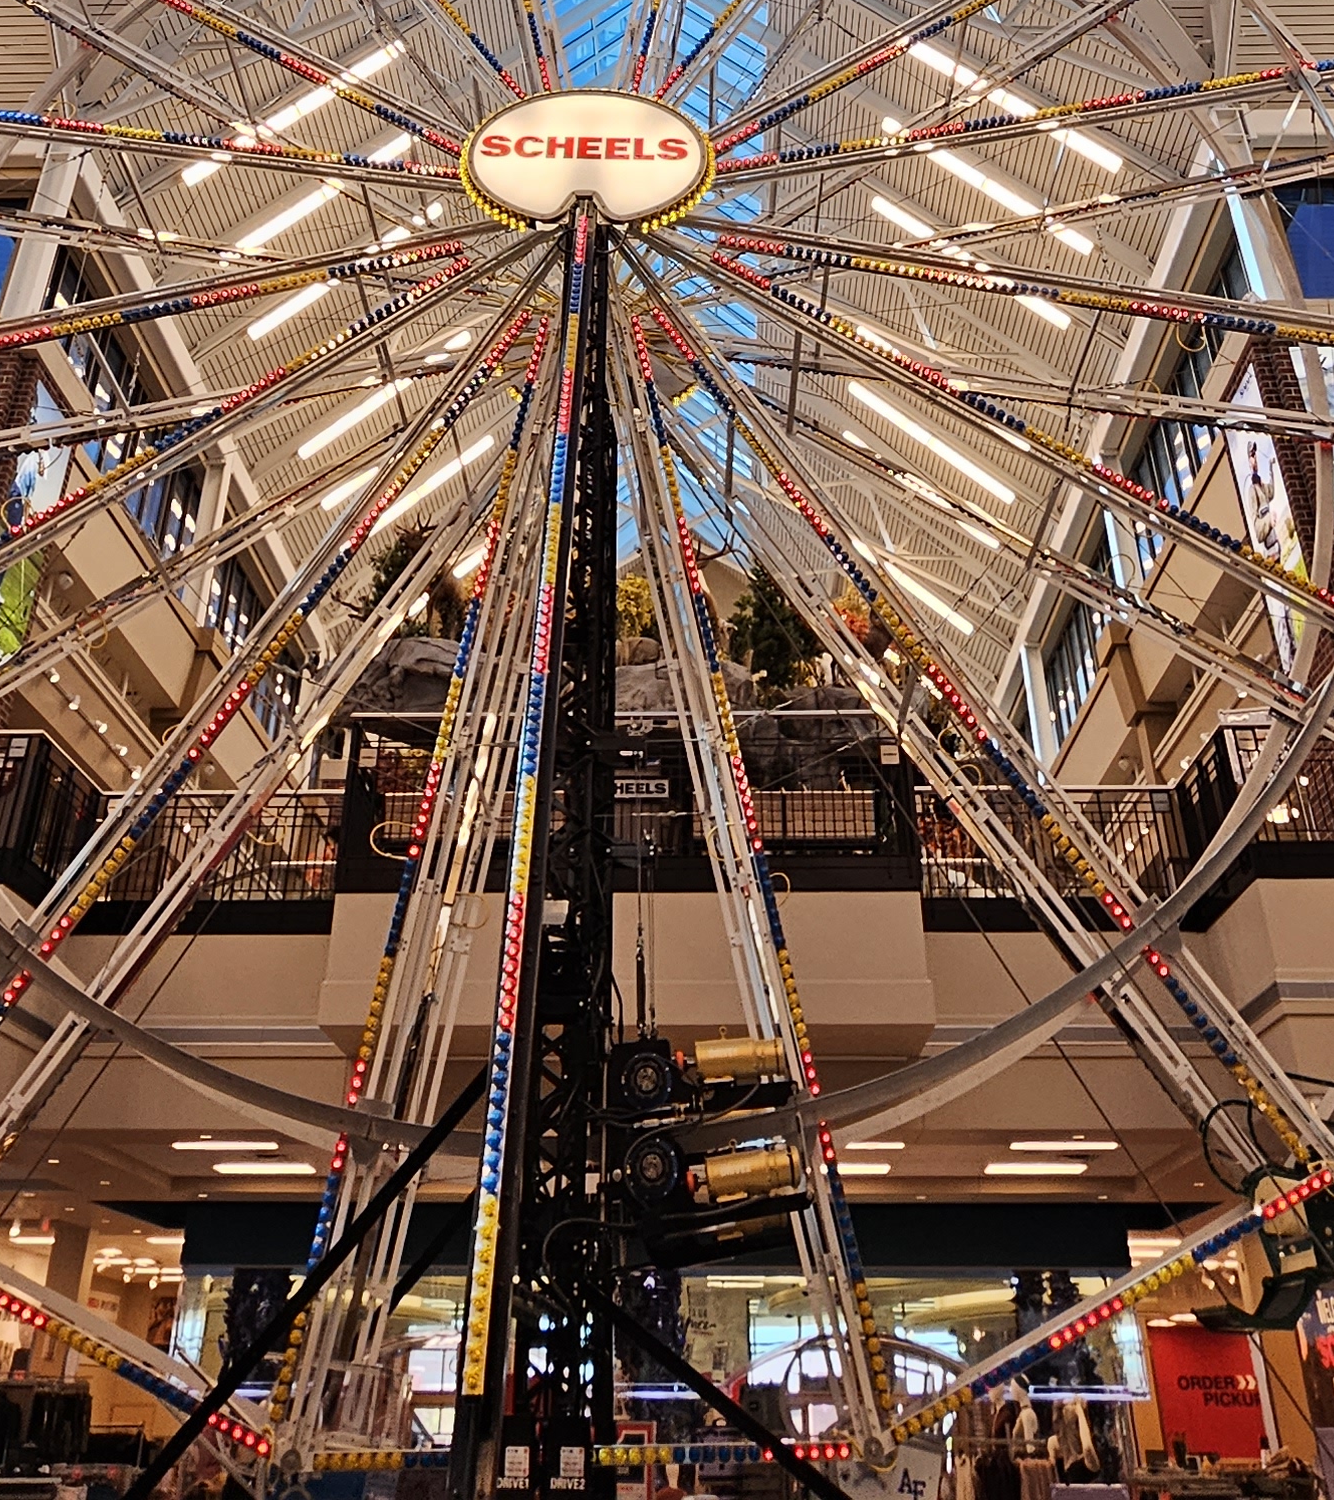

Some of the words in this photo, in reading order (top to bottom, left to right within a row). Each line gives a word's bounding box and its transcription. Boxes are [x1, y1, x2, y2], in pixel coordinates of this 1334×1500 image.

[480, 135, 688, 161] SCHEELS
[1177, 1374, 1236, 1391] ORDER
[549, 1477, 586, 1490] DRIVE2
